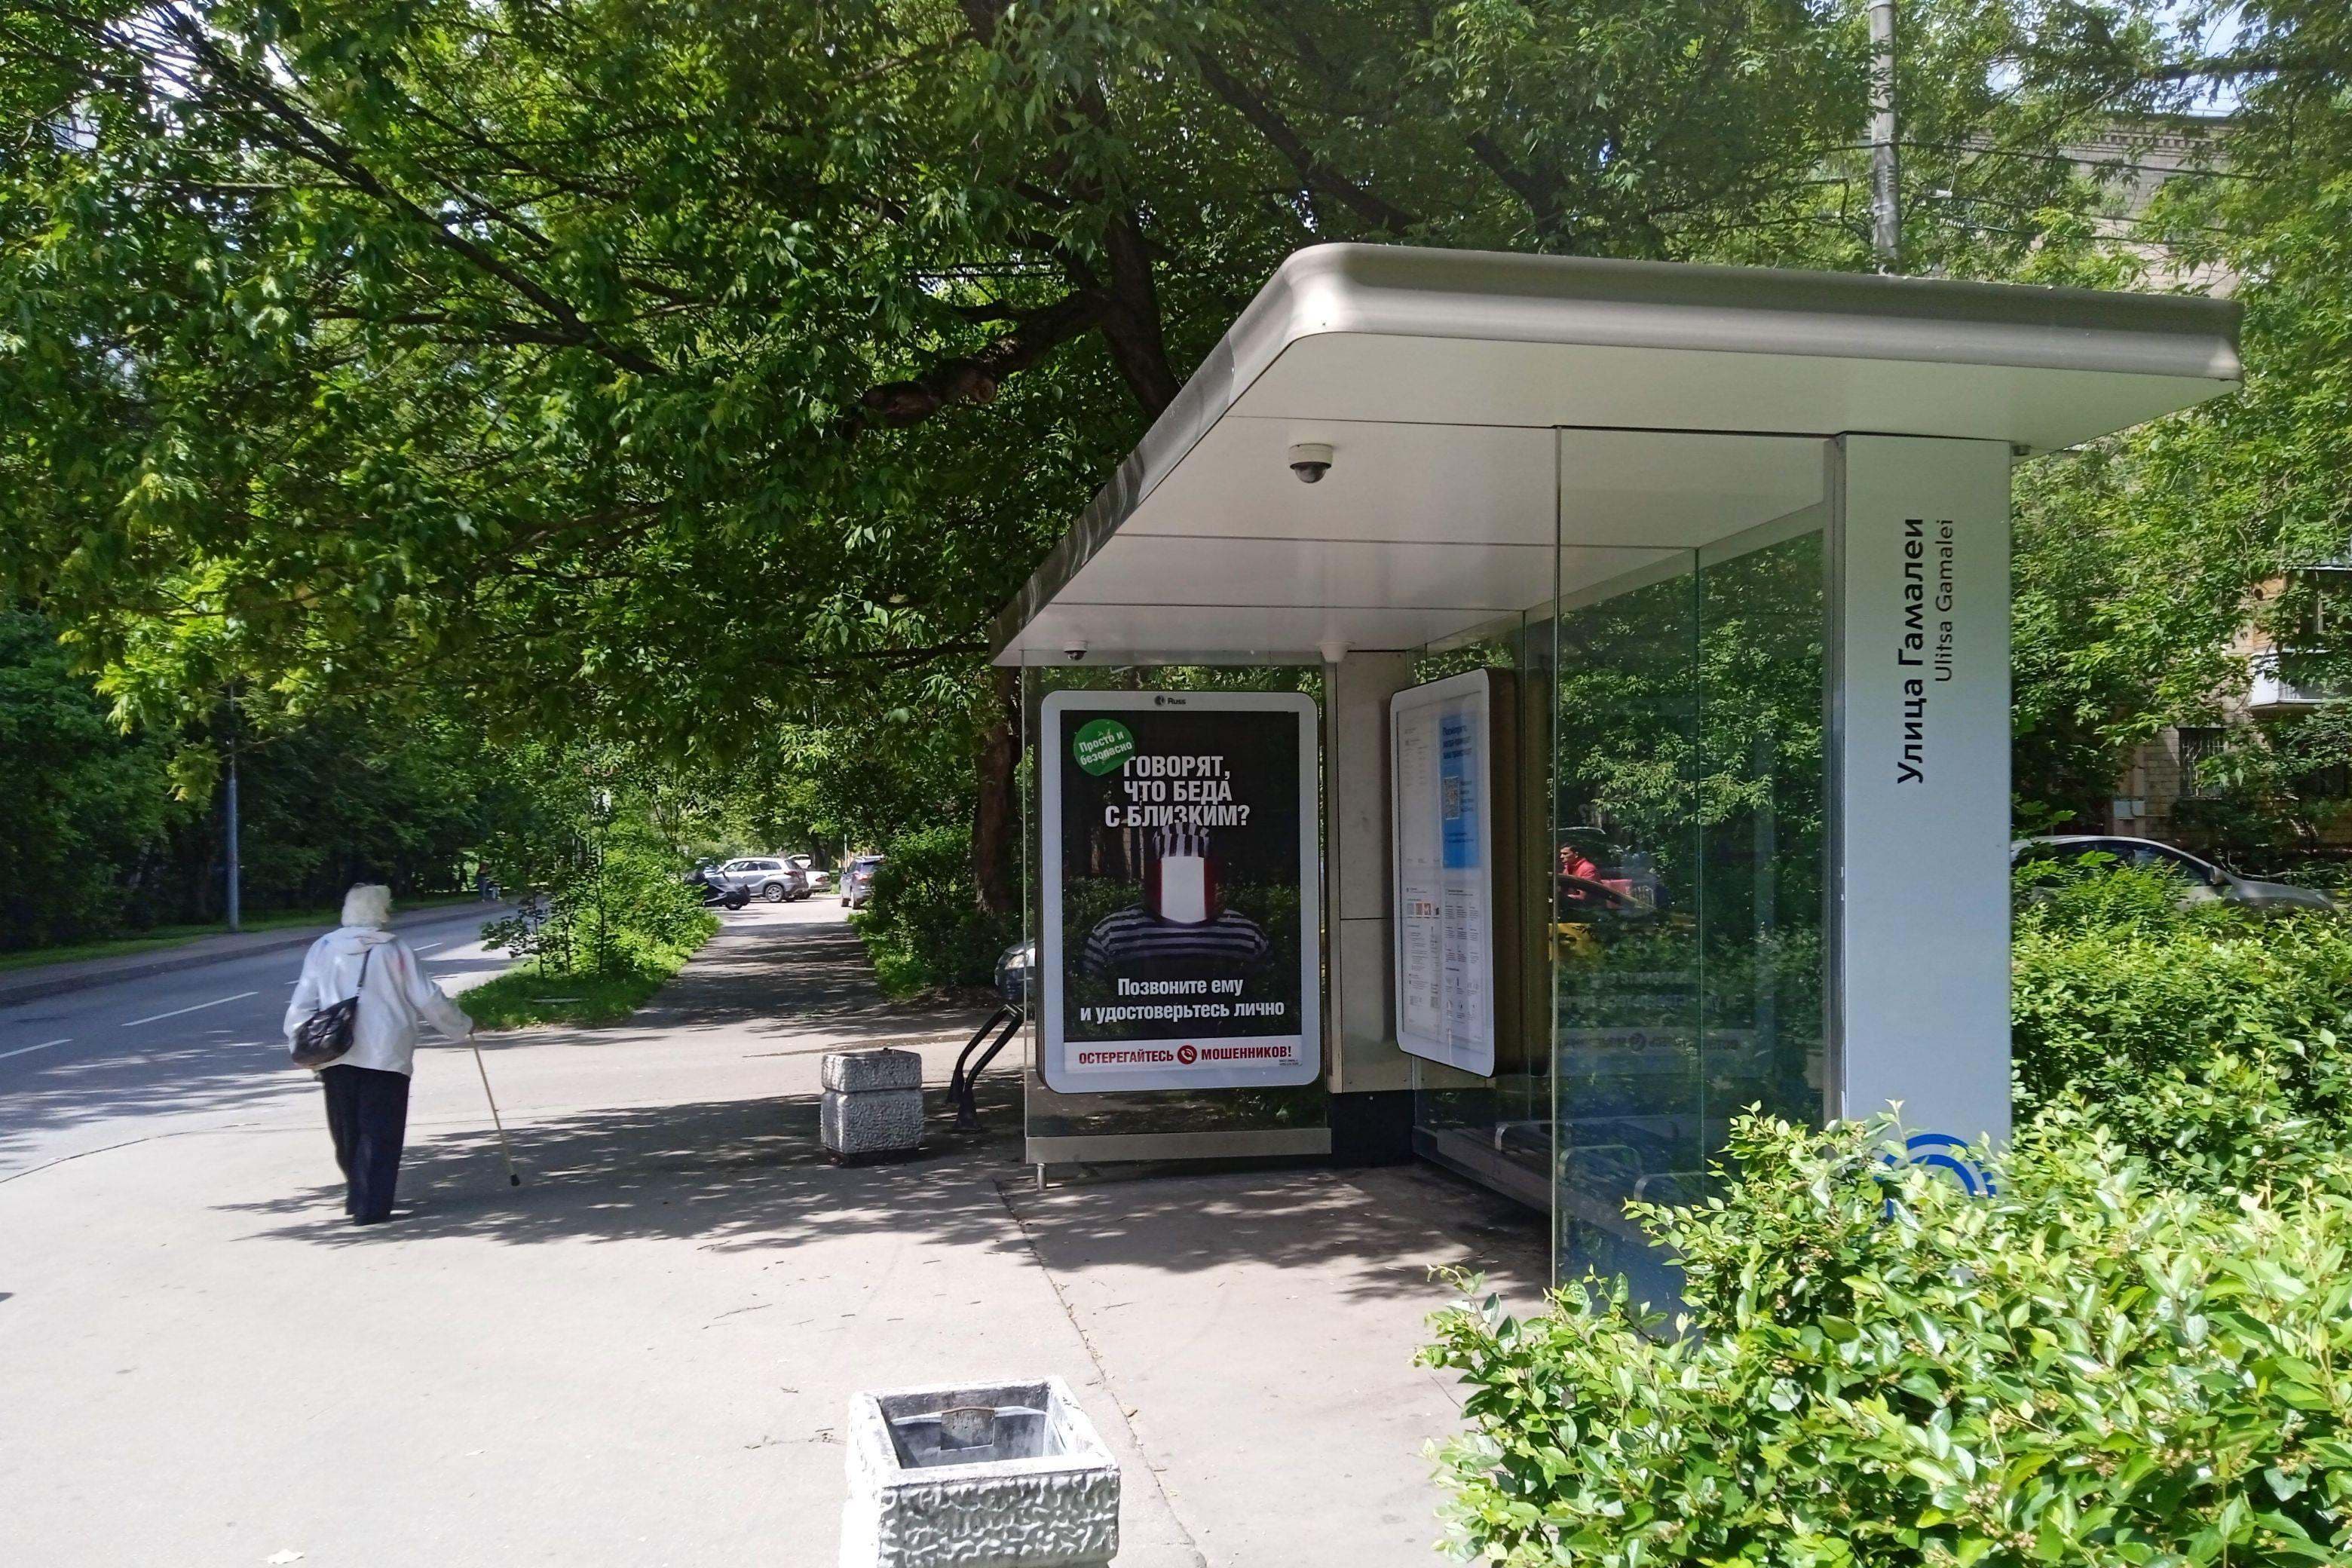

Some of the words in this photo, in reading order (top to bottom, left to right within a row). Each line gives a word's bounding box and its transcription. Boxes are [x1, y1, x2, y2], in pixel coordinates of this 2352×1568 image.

[1934, 519, 1953, 612] Gamalei
[1898, 519, 1924, 666] Гамалеи
[1934, 620, 1952, 681] Ulitsa
[1079, 734, 1116, 753] Просто
[1116, 730, 1125, 740] и
[1897, 678, 1927, 784] Улица
[1080, 742, 1133, 766] безопасно
[1123, 755, 1231, 780] ГОВОРЯТ,
[1123, 780, 1166, 802] ЧТО
[1173, 780, 1233, 806] БЕДА
[1105, 805, 1121, 828] С
[1127, 804, 1251, 827] БЛИЗКИМ?
[1118, 978, 1207, 996] Позвоните
[1211, 978, 1244, 997] ему
[1080, 1006, 1092, 1021] и
[1095, 1003, 1230, 1024] удостоверьтесь
[1233, 1001, 1285, 1017] лично
[1078, 1048, 1174, 1064] ОСТЕРЕГАЙТЕСЬ
[1200, 1045, 1292, 1060] МОШЕННИКОВ!
